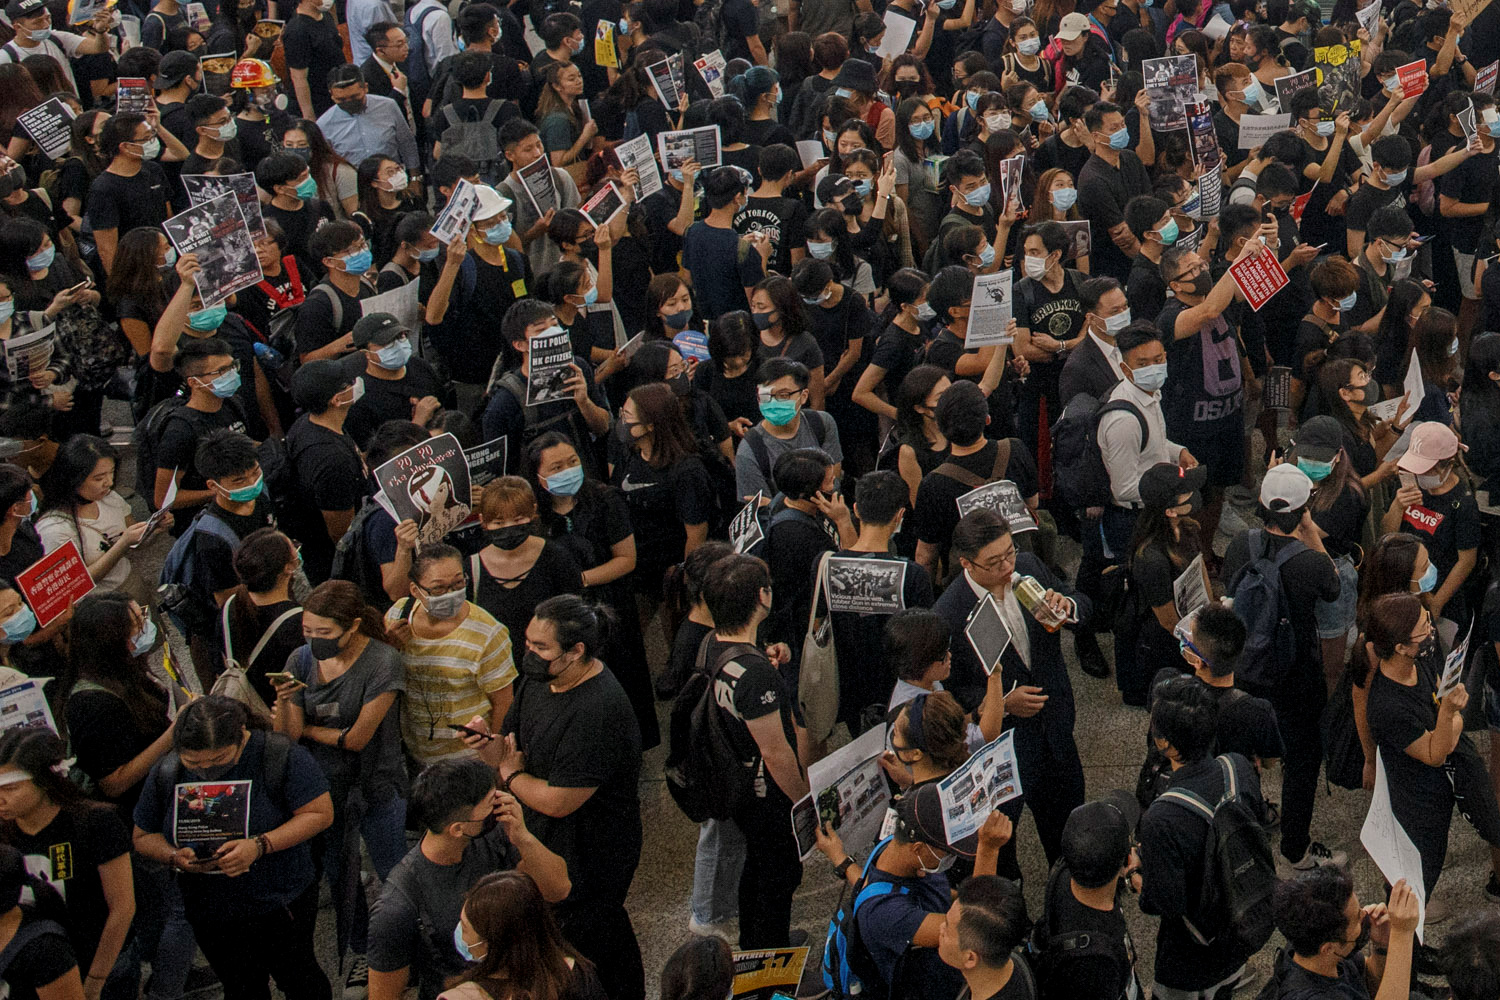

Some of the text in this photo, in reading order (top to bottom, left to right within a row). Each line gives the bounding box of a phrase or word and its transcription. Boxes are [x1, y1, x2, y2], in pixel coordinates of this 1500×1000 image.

[28, 120, 42, 128] TEAR
[37, 120, 50, 129] YOUR
[49, 114, 62, 122] FACE
[42, 119, 62, 132] MATTER
[734, 211, 746, 226] NEW
[766, 212, 781, 226] CITY
[178, 230, 210, 248] THEY SHOT
[182, 236, 212, 253] THEY SHOT
[1254, 261, 1267, 279] POLICE
[244, 272, 259, 284] POLICE
[1235, 267, 1260, 303] ENFORCEMENT
[1240, 263, 1265, 300] SELECTIVE LAW
[1249, 266, 1262, 282] ANGRY
[1260, 282, 1270, 296] WITH
[532, 340, 548, 349] 811
[532, 358, 543, 366] HK
[544, 351, 572, 364] CITIZENS
[471, 448, 489, 460] KONG
[486, 450, 500, 462] SAFE
[55, 846, 67, 879] 時代革命
